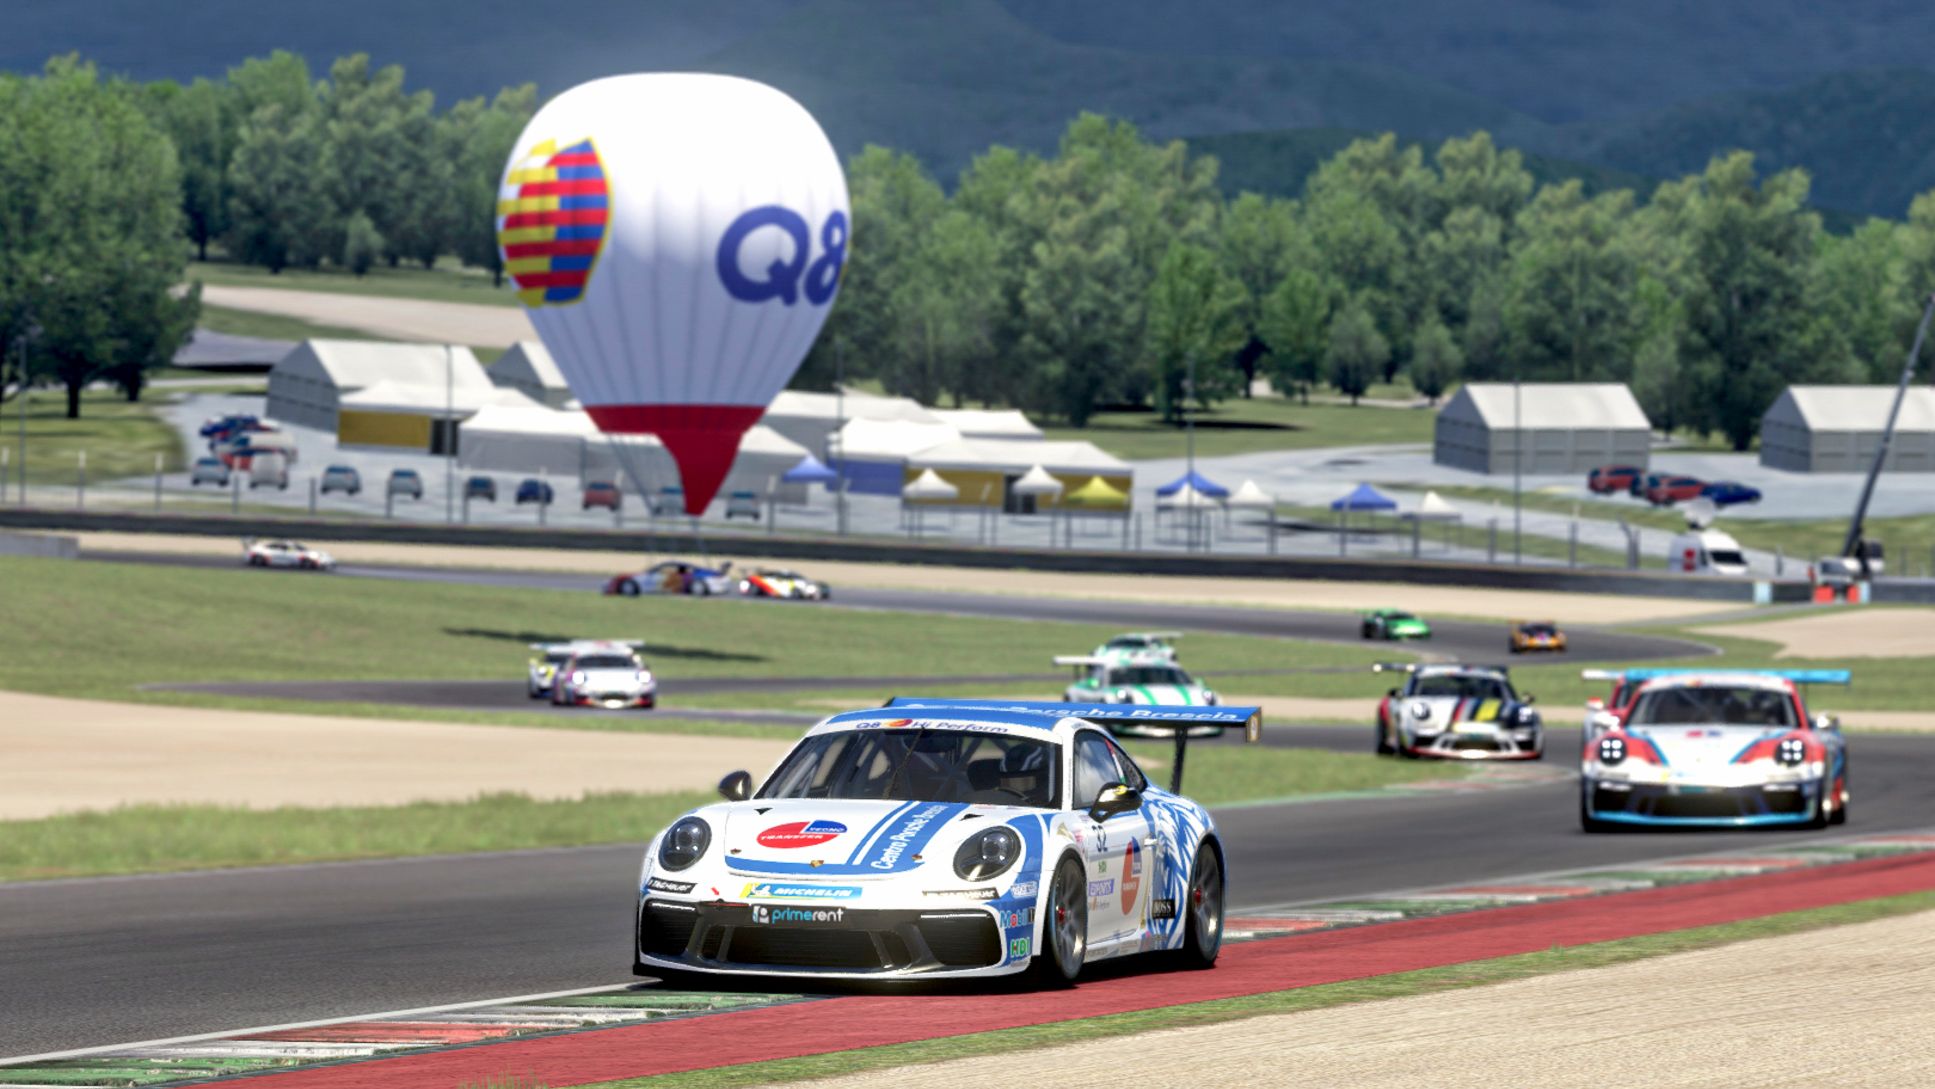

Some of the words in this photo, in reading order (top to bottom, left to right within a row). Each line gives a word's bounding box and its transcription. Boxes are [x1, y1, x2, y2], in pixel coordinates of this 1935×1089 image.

[716, 205, 847, 307] Q8
[1130, 709, 1237, 720] Brescia
[935, 722, 1009, 734] Perform
[870, 840, 909, 869] Centro
[773, 887, 854, 897] MICHELIN
[771, 907, 845, 925] primerent
[1000, 908, 1029, 929] Mobil
